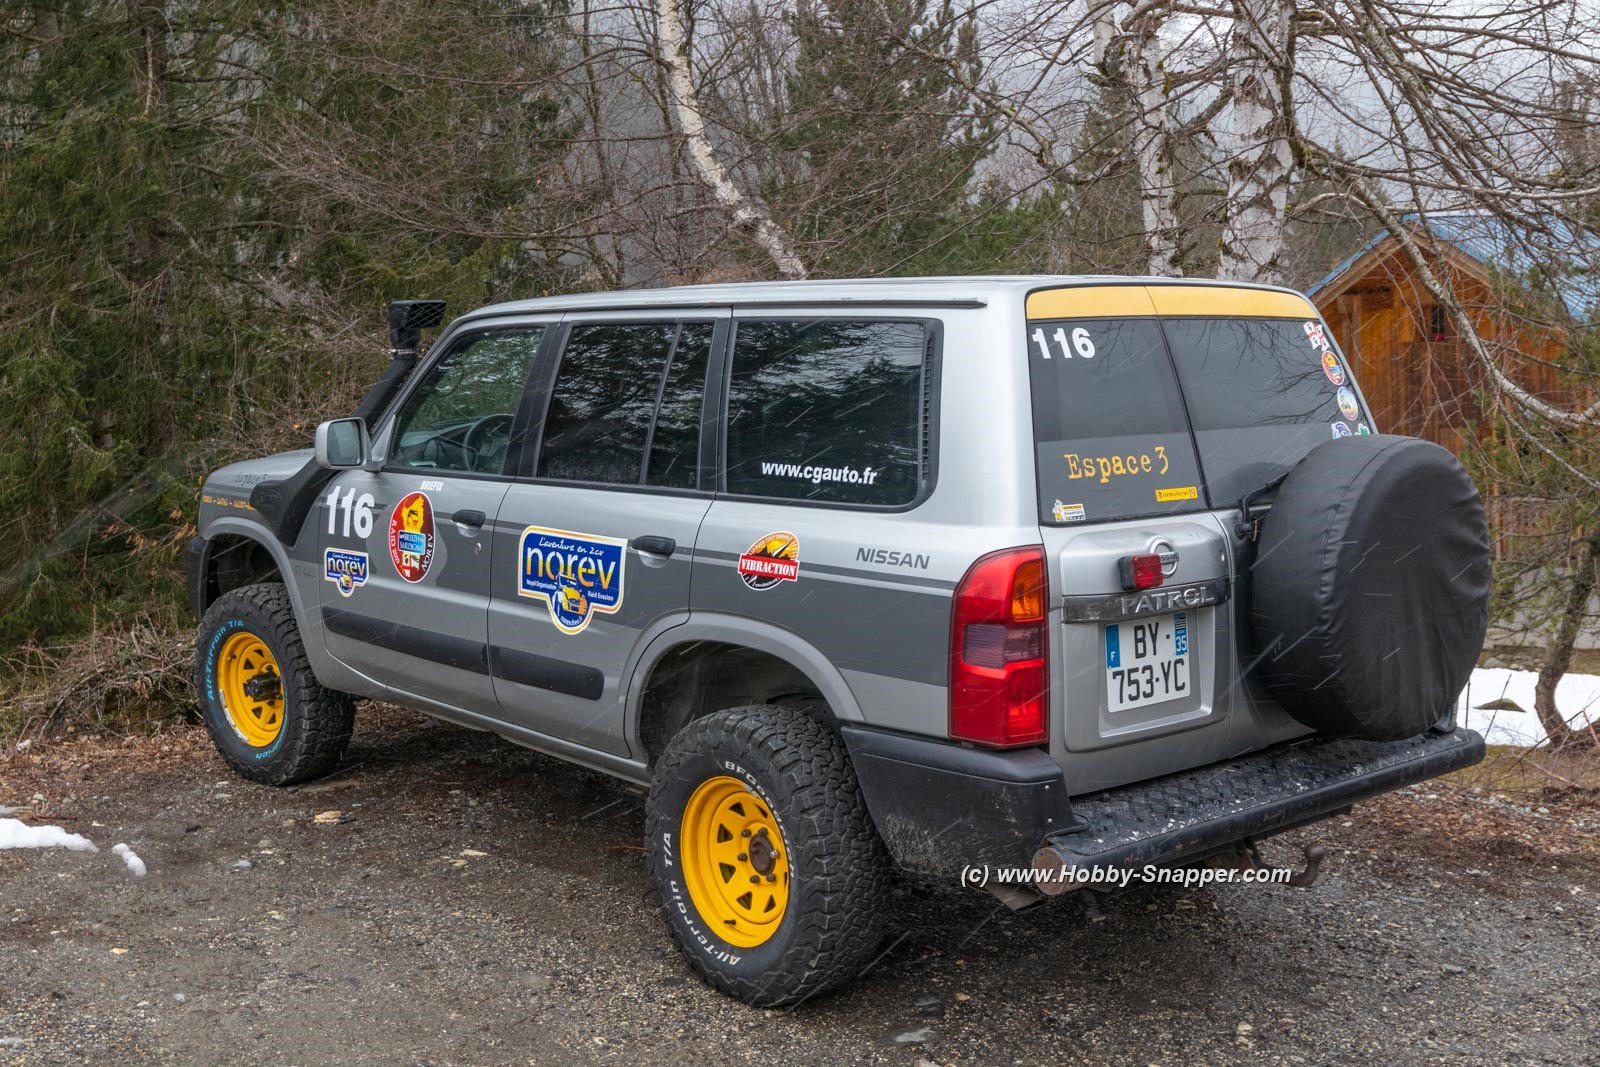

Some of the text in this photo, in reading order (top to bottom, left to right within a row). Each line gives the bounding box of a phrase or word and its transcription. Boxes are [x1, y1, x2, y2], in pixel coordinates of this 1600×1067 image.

[1032, 327, 1096, 358] 116
[761, 462, 878, 485] www.cgauto.fr
[1064, 446, 1168, 482] Espace 3
[326, 485, 375, 539] 116
[390, 519, 398, 549] RAID
[539, 537, 575, 552] L'aventure
[576, 545, 588, 554] en
[327, 557, 366, 577] norev
[421, 533, 434, 572] NOREV
[741, 558, 797, 577] VIBRACTION
[855, 547, 931, 570] NISSAN
[526, 547, 616, 590] norev
[1120, 585, 1215, 615] PATROL
[228, 619, 245, 628] T/A
[1110, 650, 1117, 662] F
[1175, 634, 1188, 653] 35
[664, 832, 673, 868] T/A
[670, 880, 742, 967] All-Terrain
